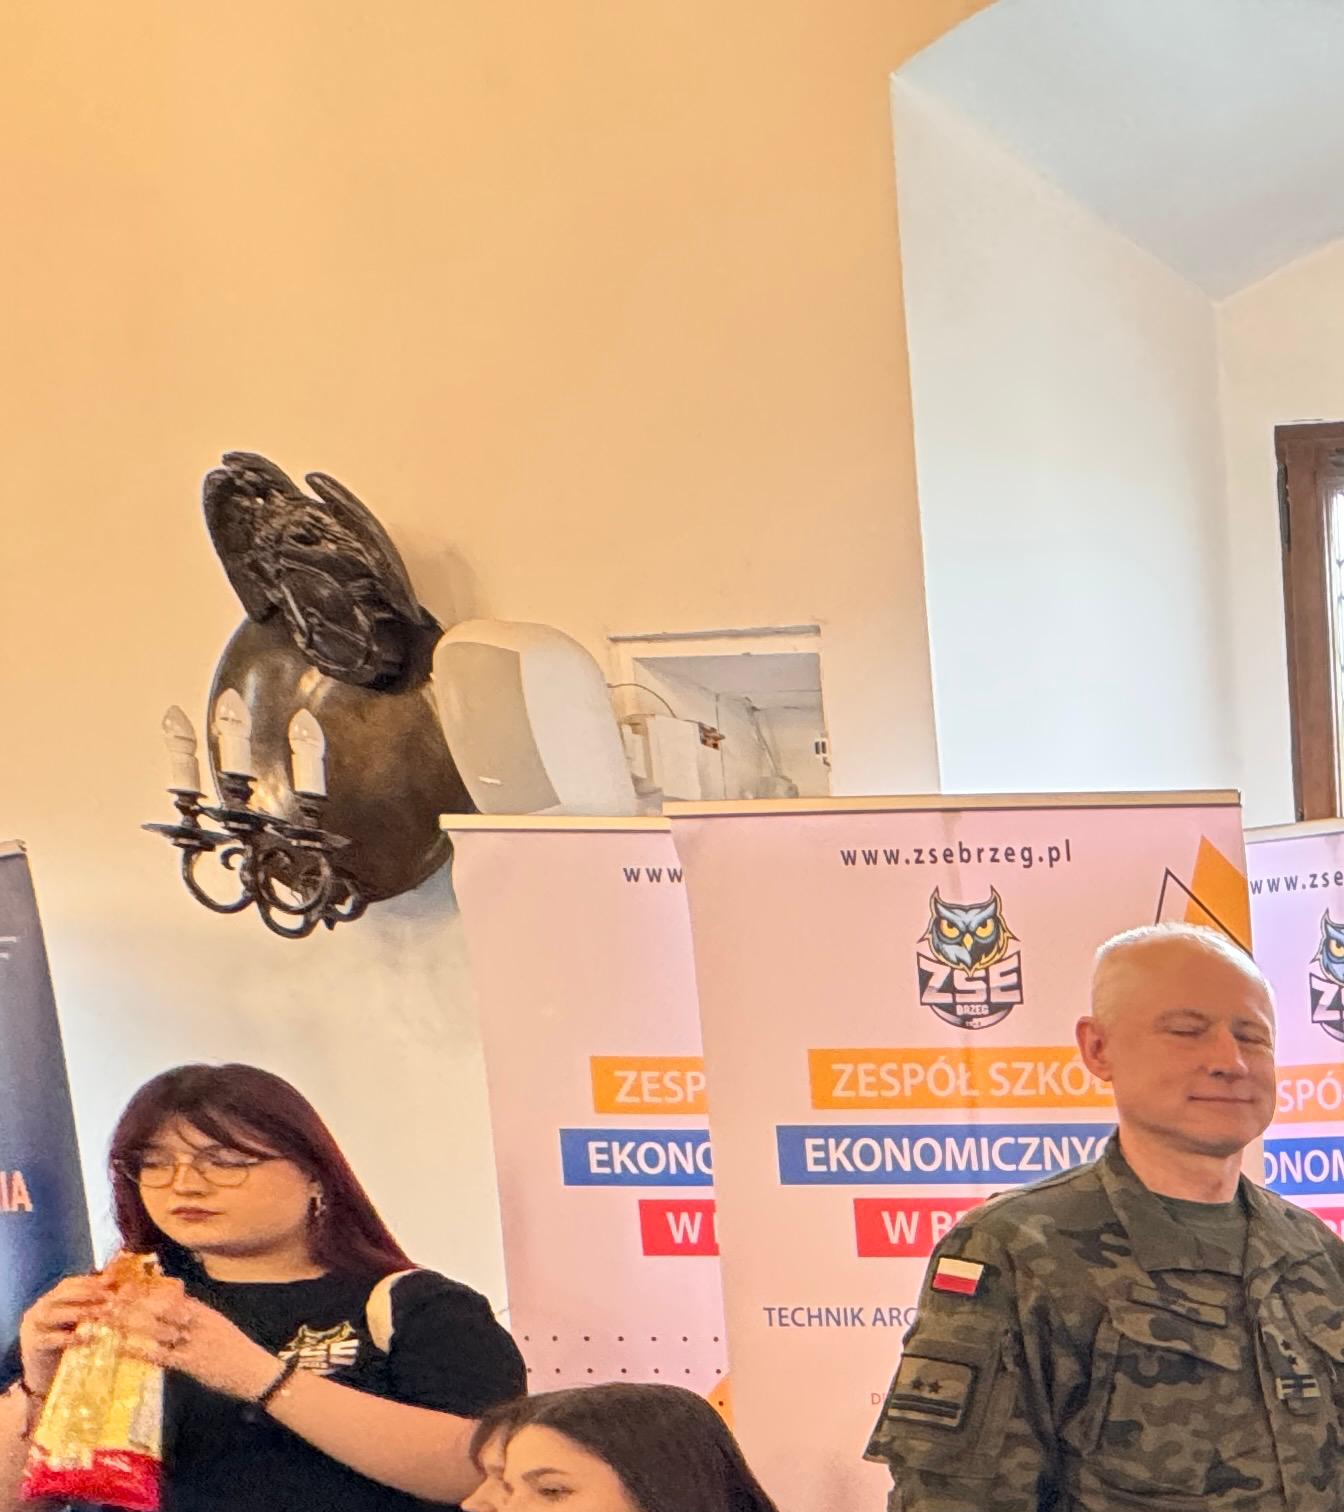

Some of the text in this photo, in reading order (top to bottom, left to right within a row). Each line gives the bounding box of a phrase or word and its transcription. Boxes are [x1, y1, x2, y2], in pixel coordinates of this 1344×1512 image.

[840, 839, 1071, 869] www.zsebrzeg.pl
[919, 953, 1022, 1003] ZSE
[832, 1056, 980, 1098] ZESPÓŁ
[666, 1211, 702, 1244] W
[882, 1211, 920, 1245] W
[763, 1306, 866, 1328] TECHNIK
